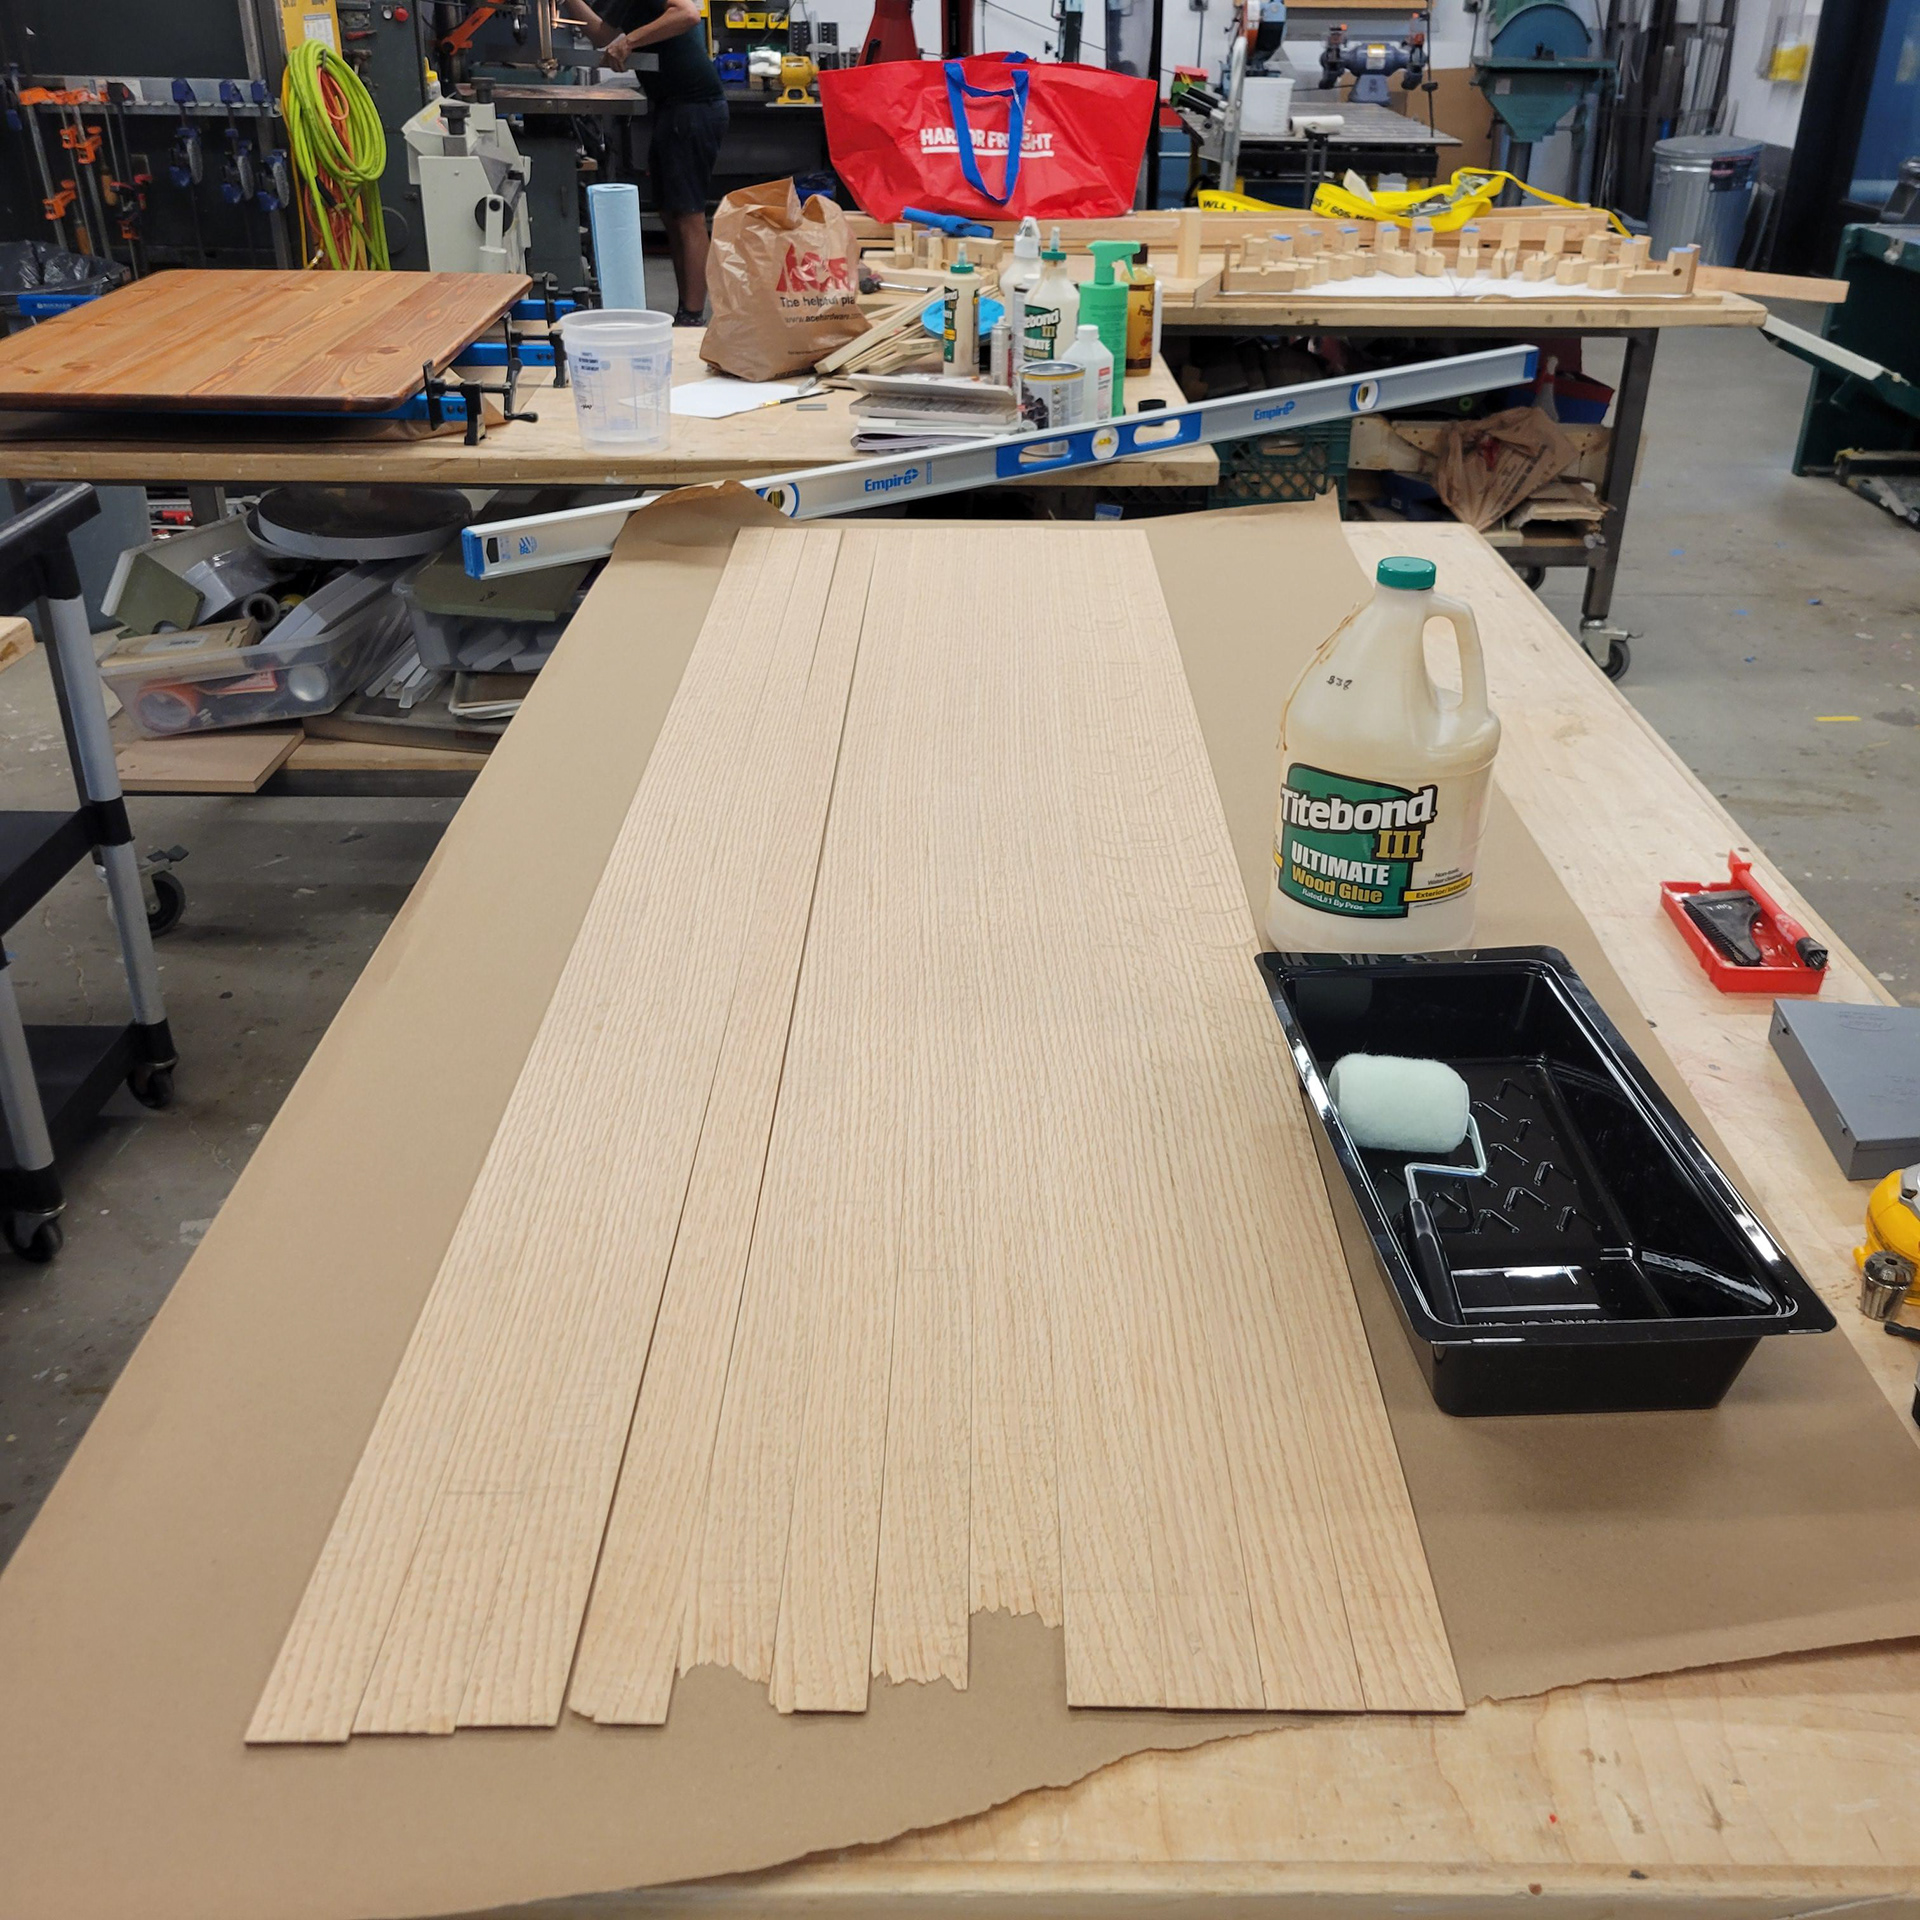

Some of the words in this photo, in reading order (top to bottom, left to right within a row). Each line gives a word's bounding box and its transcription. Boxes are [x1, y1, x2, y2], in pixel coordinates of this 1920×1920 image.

[920, 127, 986, 147] HAROR
[987, 130, 1053, 151] FRGHT
[780, 296, 800, 308] The
[803, 294, 838, 308] helpful
[1253, 405, 1291, 421] Empire
[865, 473, 913, 492] Empire
[1281, 788, 1436, 831] Titebond
[1376, 830, 1422, 859] III
[1291, 840, 1390, 886] ULTIMATE
[1292, 864, 1336, 896] Wood
[1338, 882, 1383, 904] Glue
[1302, 888, 1323, 903] Rated
[1333, 899, 1344, 908] By
[1345, 901, 1364, 911] Pros
